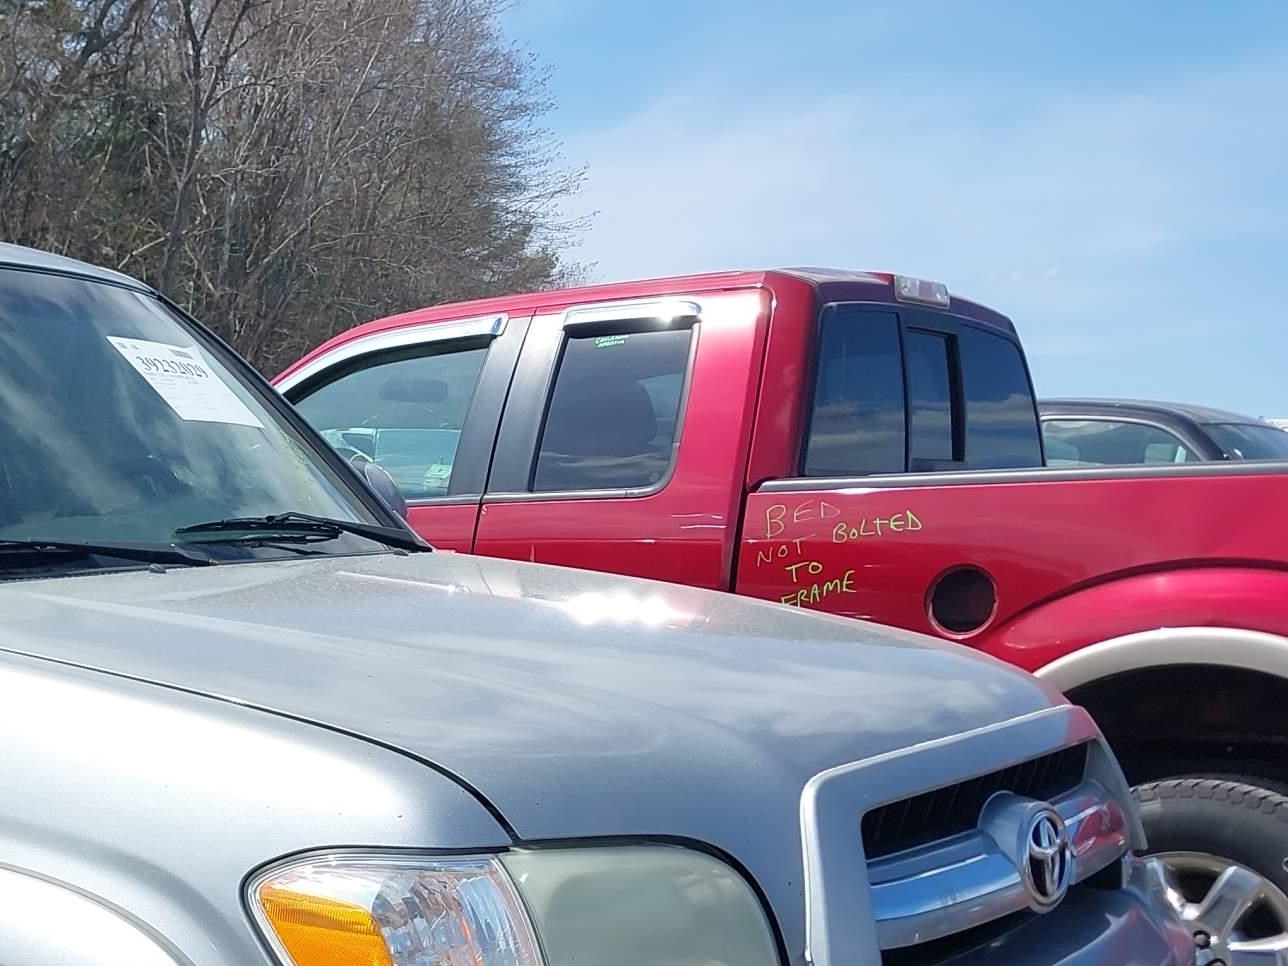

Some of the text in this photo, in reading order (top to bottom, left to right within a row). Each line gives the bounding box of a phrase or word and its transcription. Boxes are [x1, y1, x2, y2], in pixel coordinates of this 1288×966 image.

[756, 510, 922, 567] NOT BOLTED
[765, 499, 841, 539] BED
[780, 570, 858, 608] FRAME
[785, 561, 823, 583] TO
